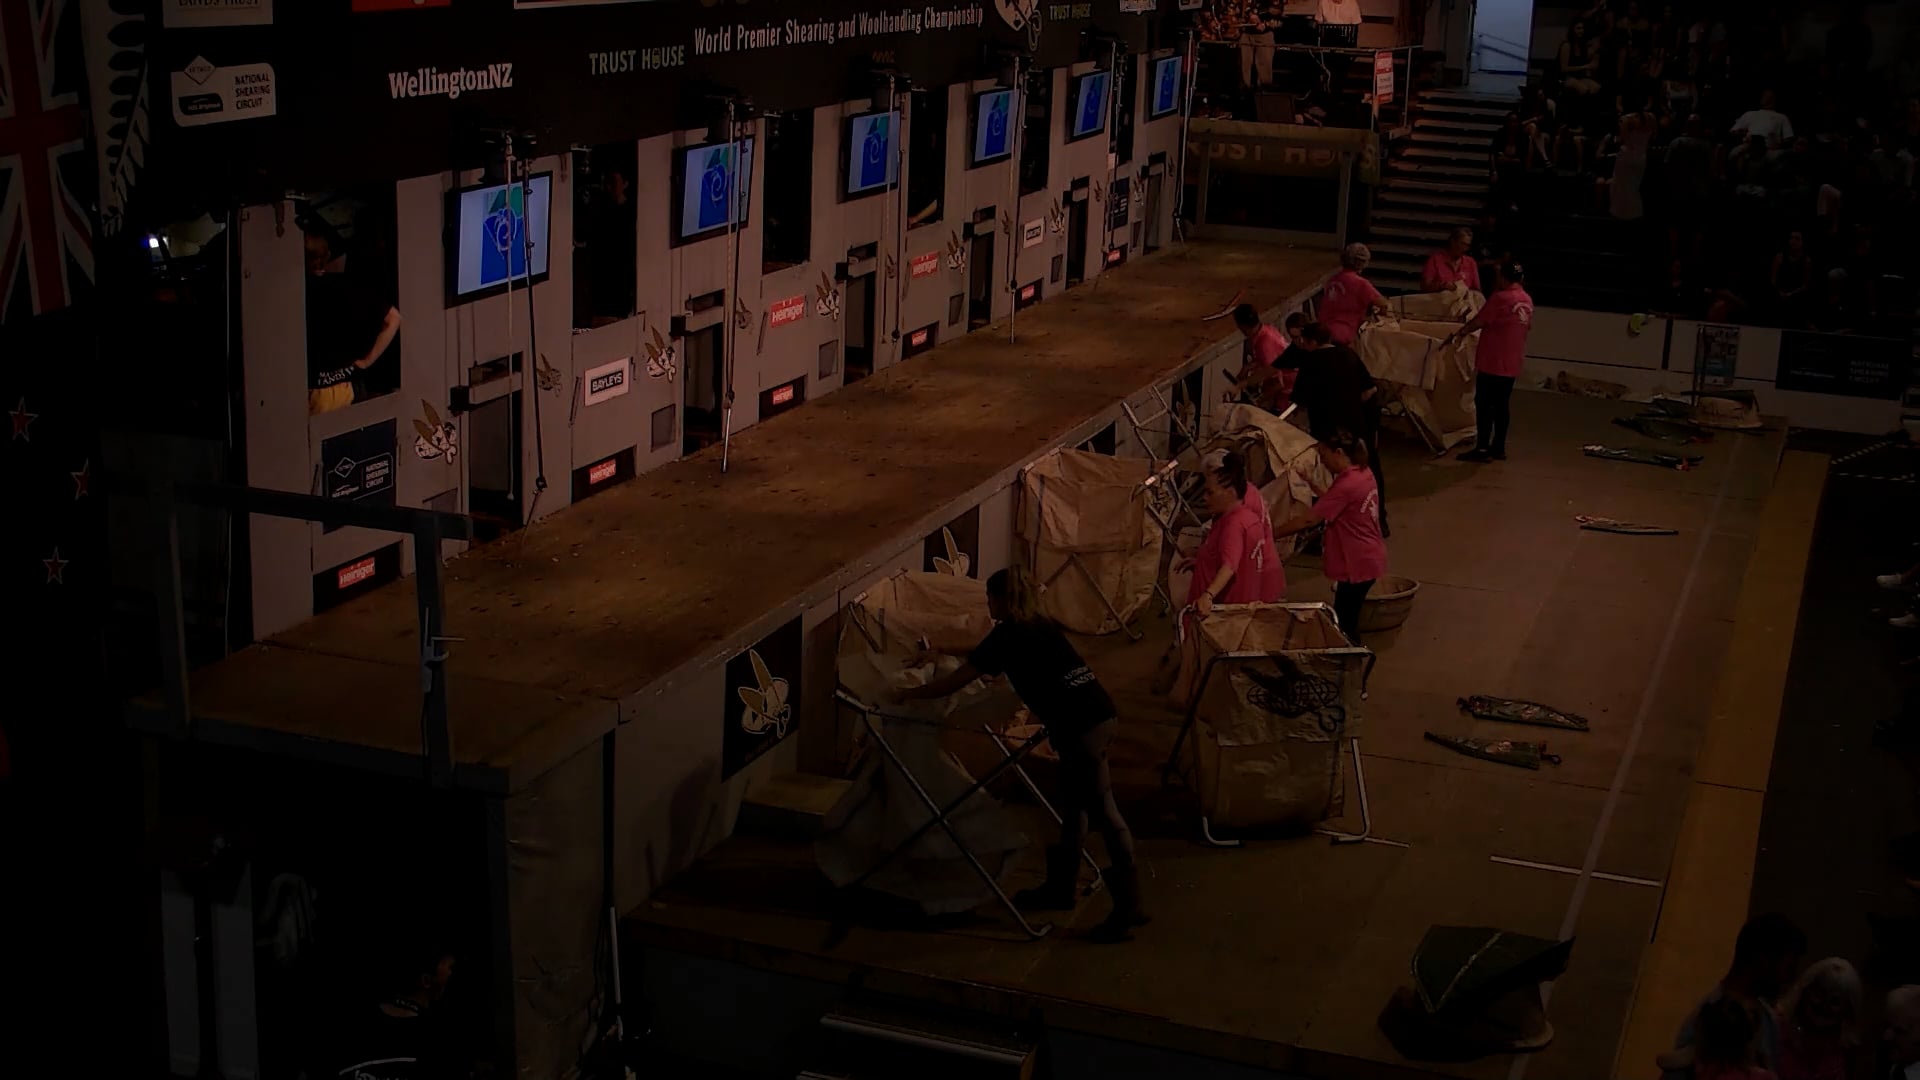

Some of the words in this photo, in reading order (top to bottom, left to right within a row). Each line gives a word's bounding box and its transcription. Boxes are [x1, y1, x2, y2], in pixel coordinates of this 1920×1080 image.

[1049, 4, 1071, 21] TRUST
[694, 24, 732, 56] World
[736, 22, 782, 52] Premier
[785, 17, 835, 45] Shearing
[838, 14, 857, 40] and
[858, 9, 923, 36] Woolhandling
[924, 2, 984, 32] Championship
[588, 49, 638, 76] TRUST
[641, 44, 686, 71] HOUSE
[235, 73, 270, 86] NATIONAL
[387, 62, 513, 100] WellingtonNZ
[235, 84, 271, 98] SHEARING
[235, 97, 263, 110] CIRCUIT
[592, 372, 622, 391] BAYLEYS
